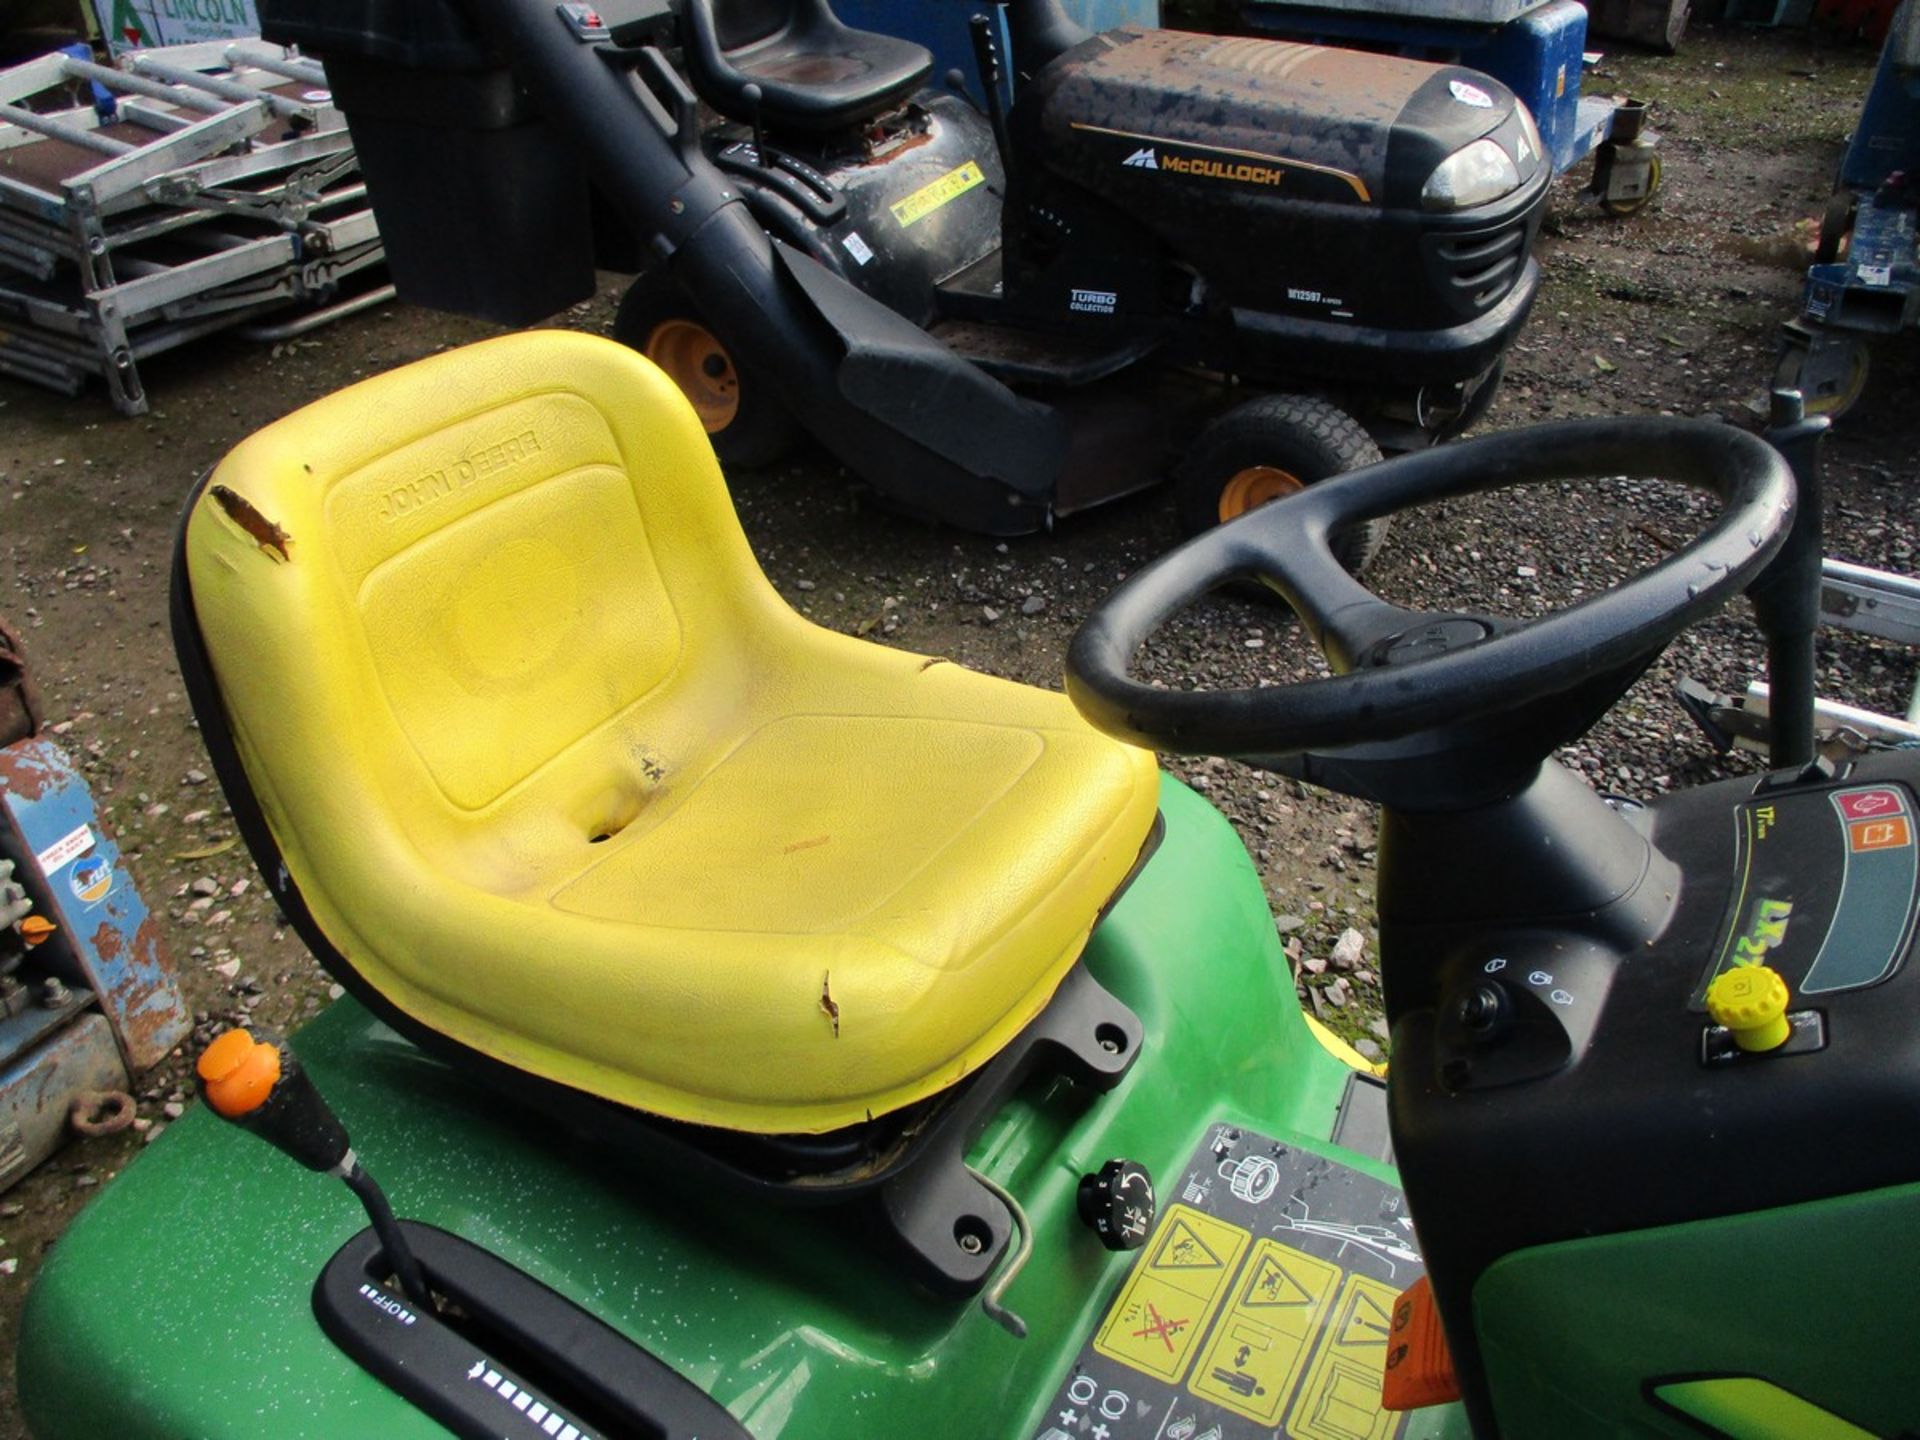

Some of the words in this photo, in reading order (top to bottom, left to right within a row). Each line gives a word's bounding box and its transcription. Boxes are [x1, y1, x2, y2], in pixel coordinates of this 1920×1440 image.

[163, 0, 248, 26] LINCOLN
[1162, 155, 1282, 186] McCULLOCH
[1070, 301, 1115, 313] COLLECTION
[1071, 289, 1117, 305] TURBO
[380, 469, 453, 518] JOHN
[451, 430, 543, 487] DEERE
[372, 1295, 401, 1315] OFF
